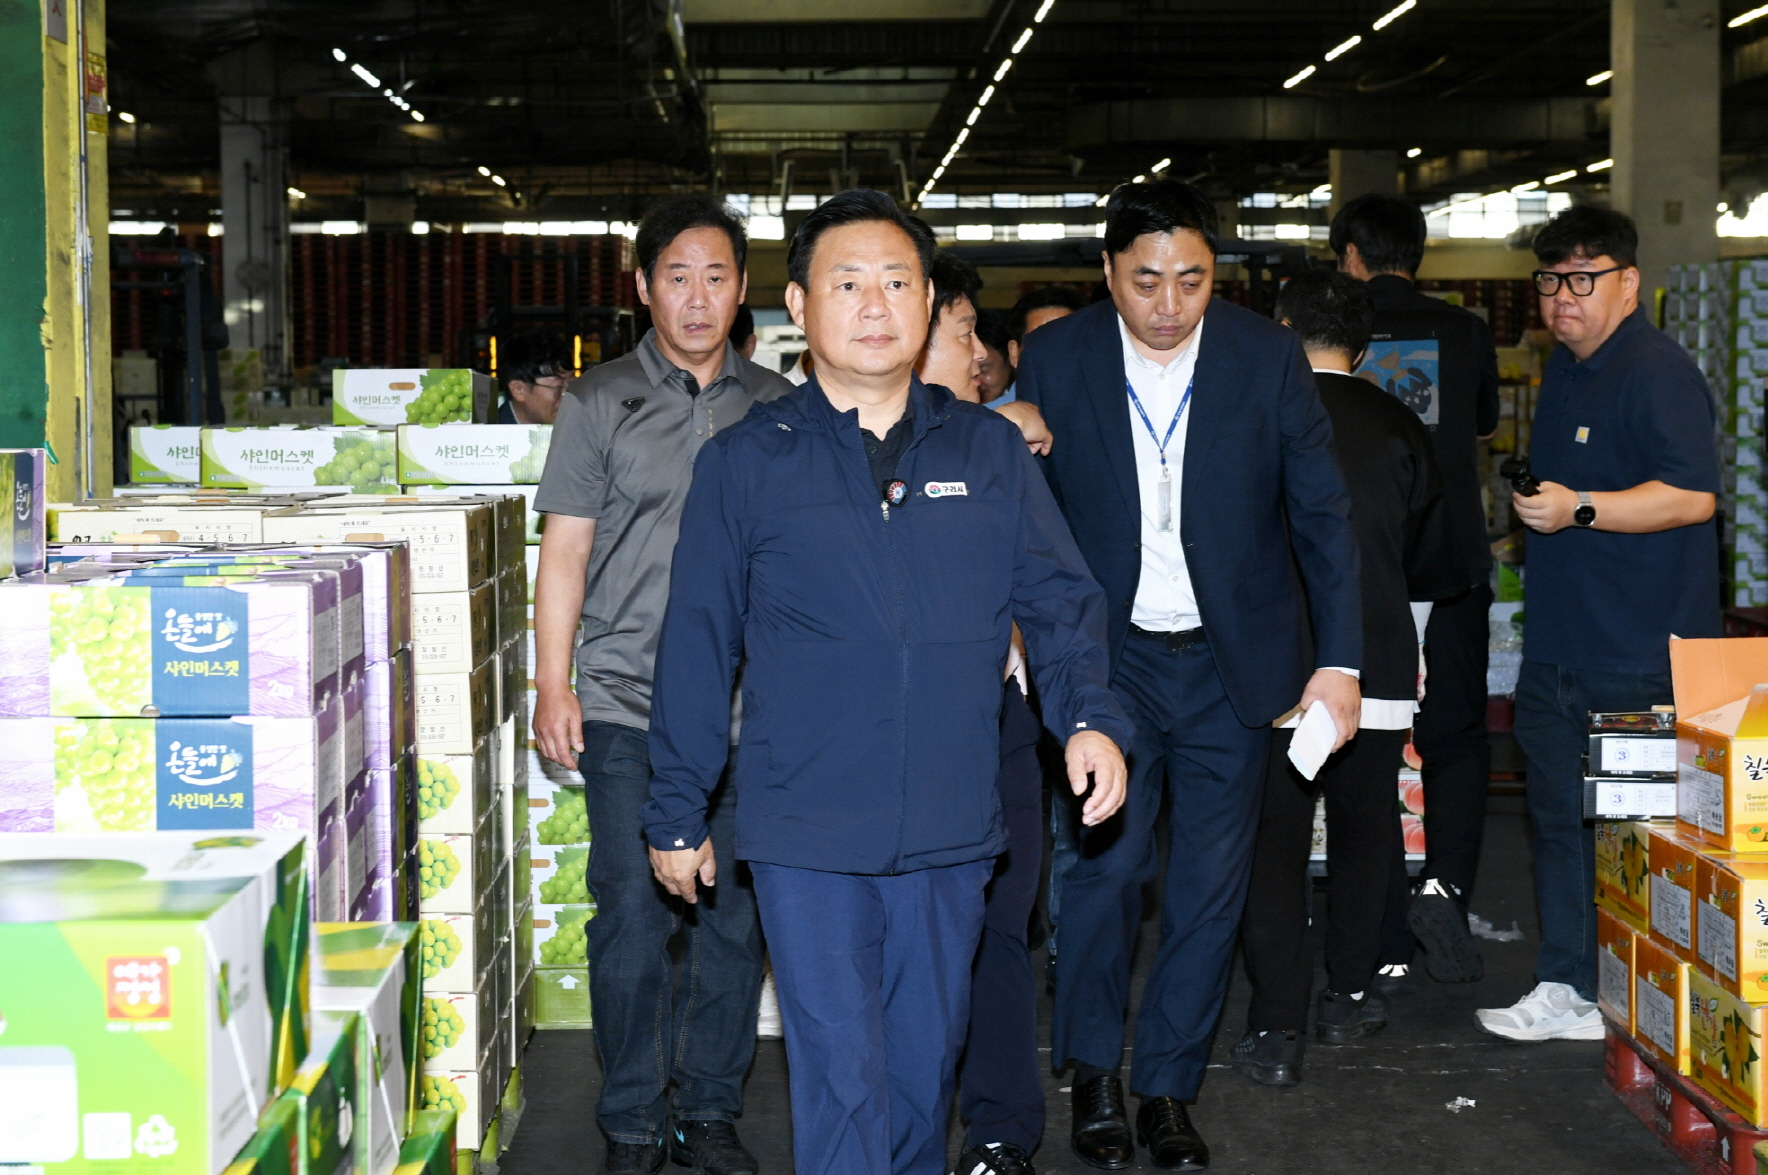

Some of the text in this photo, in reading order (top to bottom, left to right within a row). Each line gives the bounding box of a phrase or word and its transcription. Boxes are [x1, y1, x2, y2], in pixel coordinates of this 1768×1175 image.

[352, 395, 401, 405] 샤인머스켓
[240, 449, 314, 464] 샤인머스켓
[435, 445, 510, 459] 샤인머스켓
[163, 660, 239, 677] 샤인머스켓
[1743, 754, 1768, 781] 칠
[168, 792, 244, 809] 샤인머스켓
